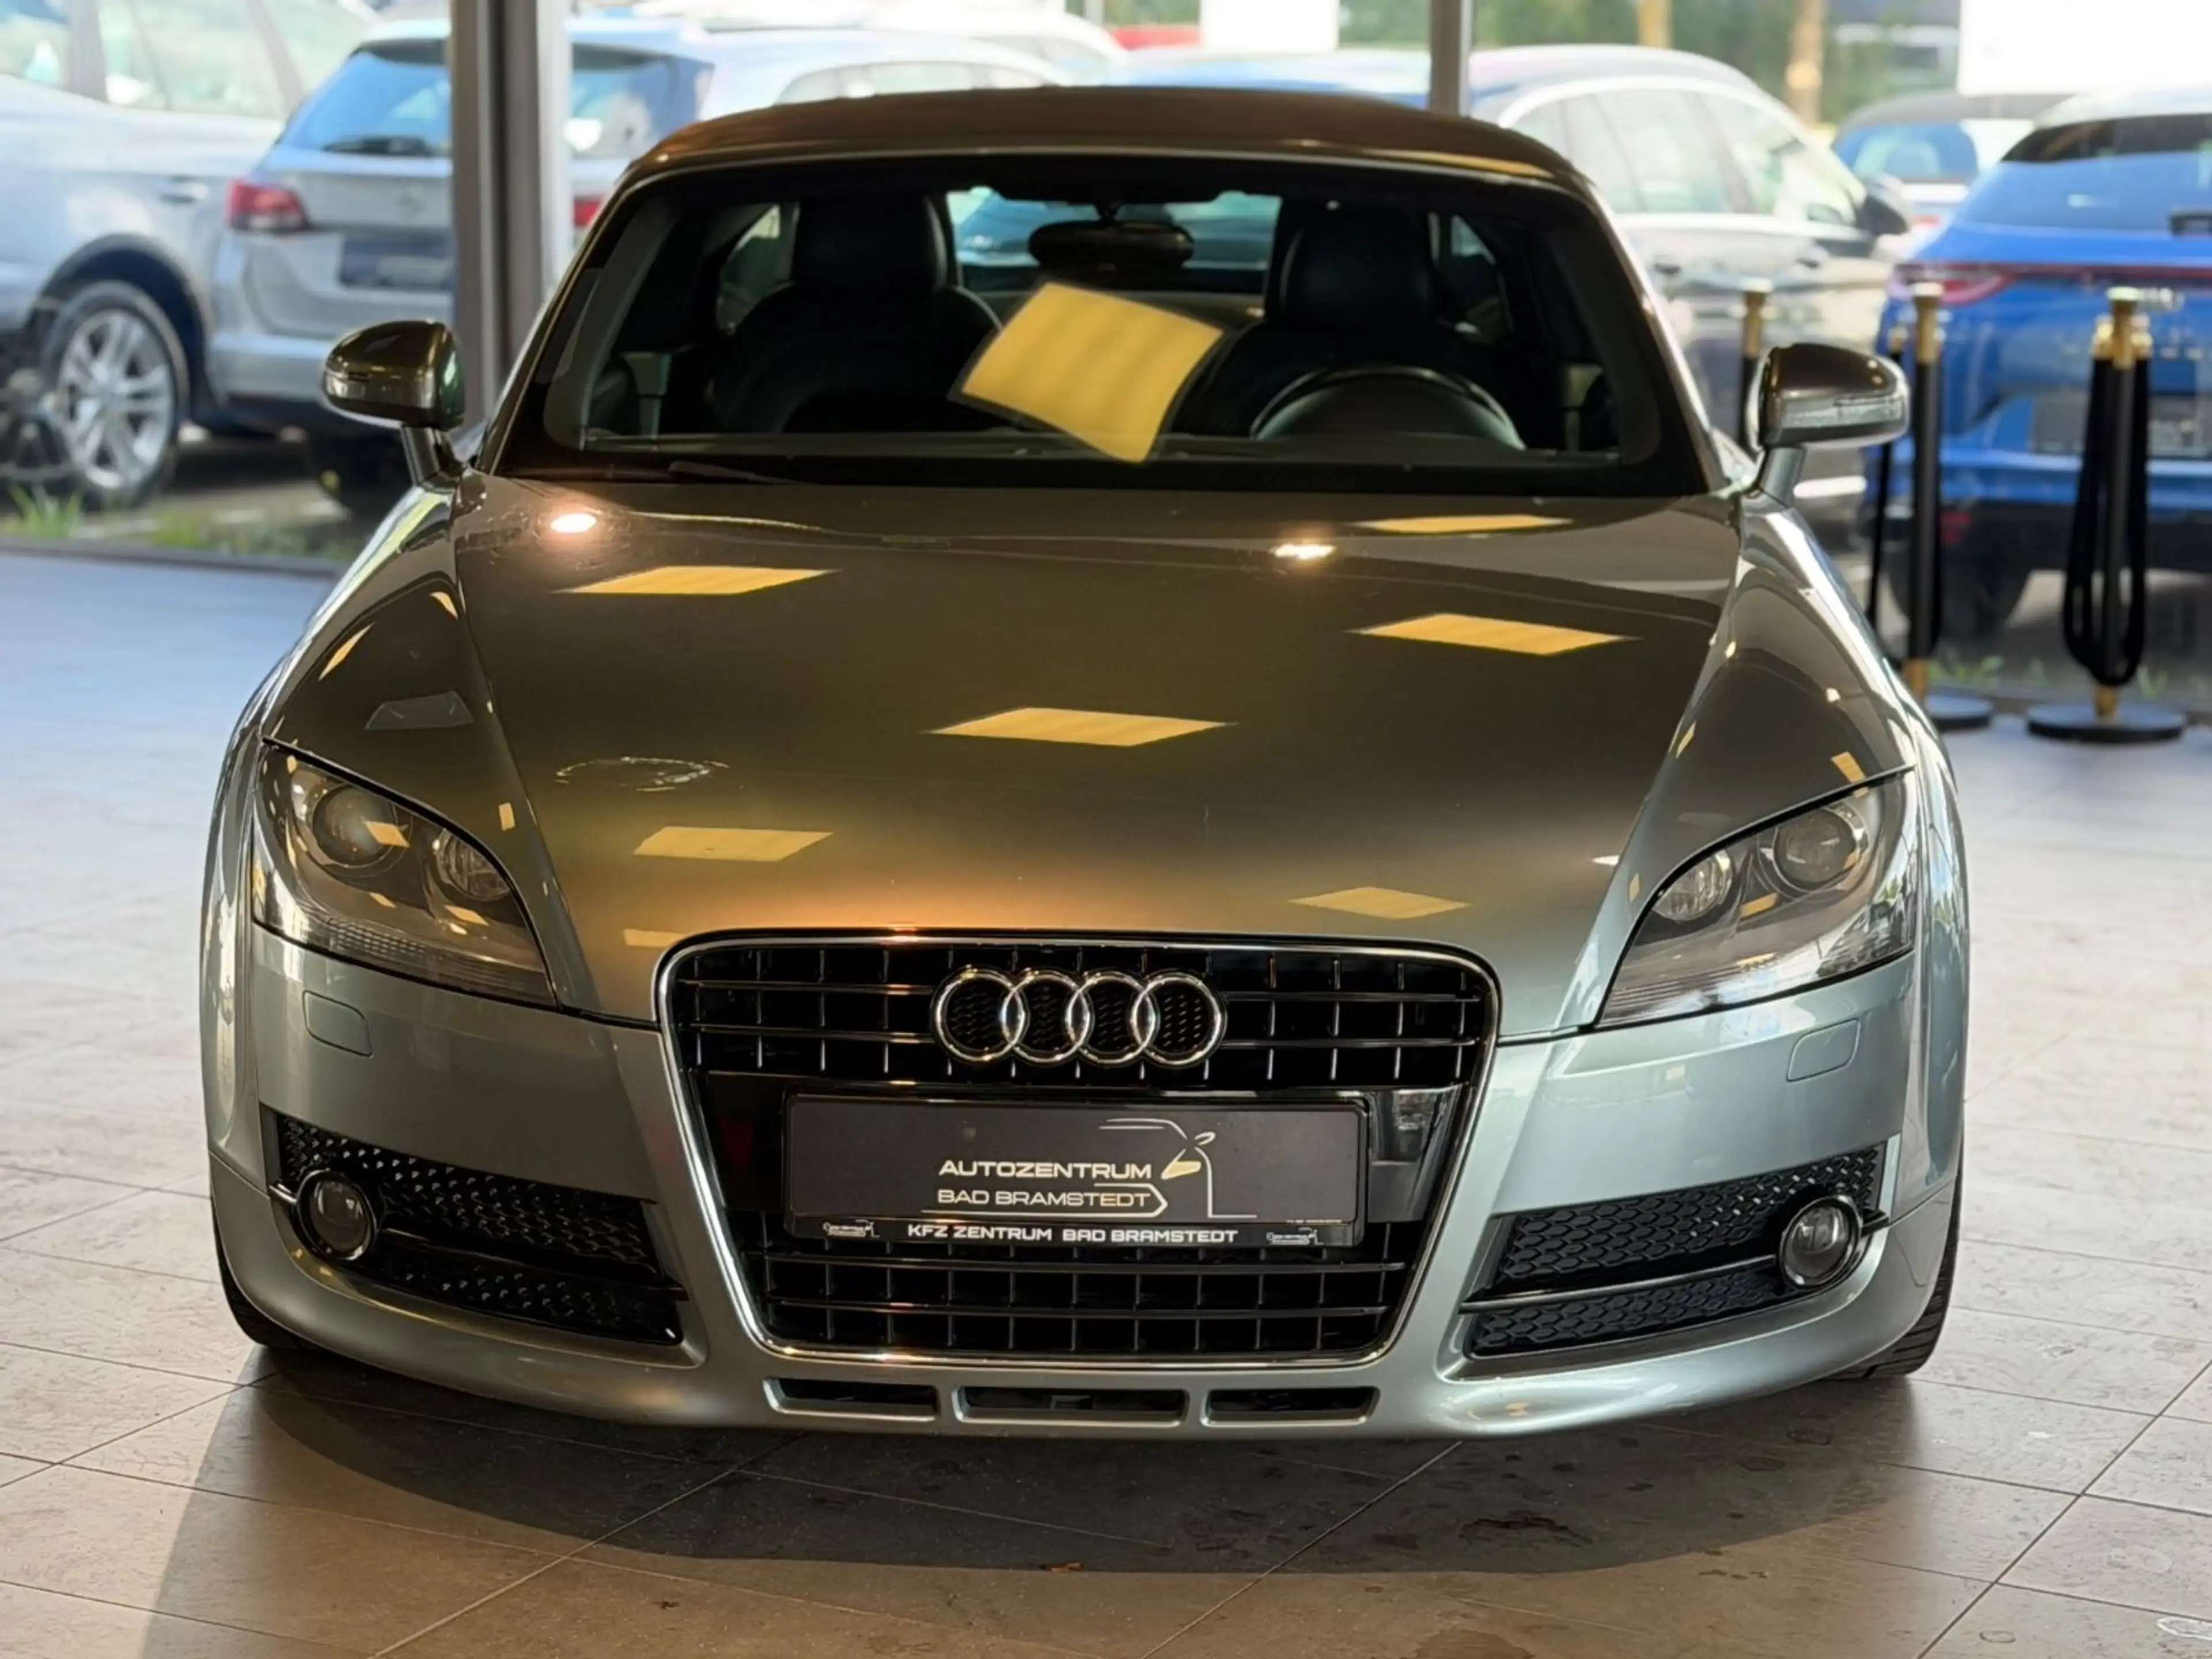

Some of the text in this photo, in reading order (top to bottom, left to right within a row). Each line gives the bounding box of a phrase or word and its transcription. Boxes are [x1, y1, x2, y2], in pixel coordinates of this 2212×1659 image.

[939, 1160, 1152, 1179] AUTOZENTRUM
[938, 1190, 1150, 1207] BAD BRAMSTEDT
[908, 1224, 1238, 1243] KFZ ZENTRUM BAD BRAMSTEDT
